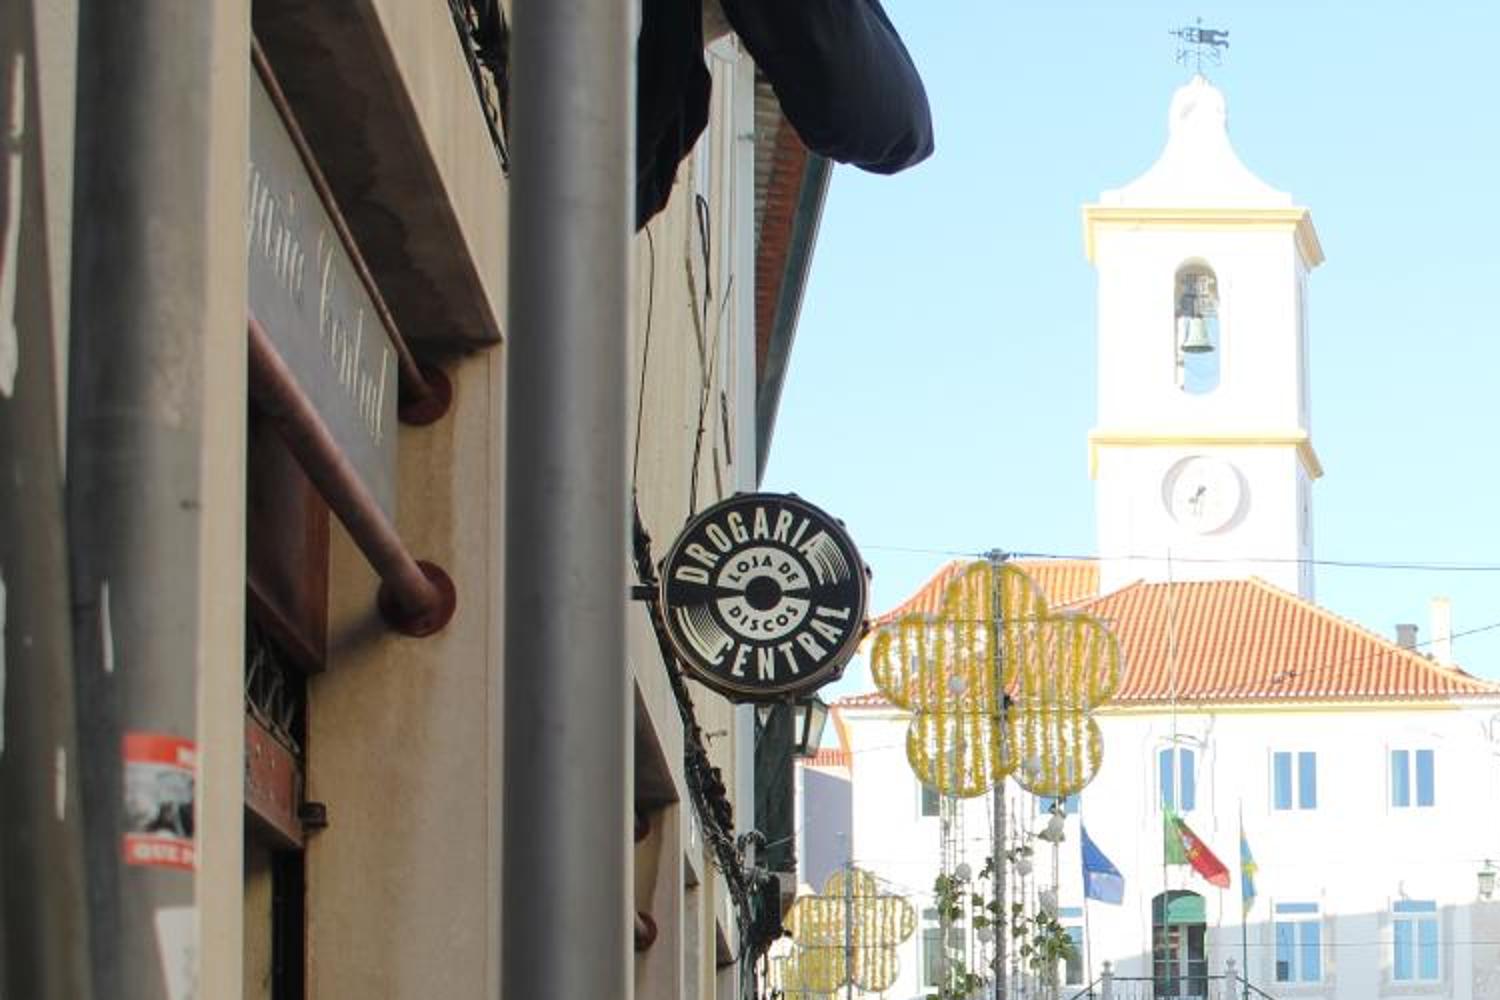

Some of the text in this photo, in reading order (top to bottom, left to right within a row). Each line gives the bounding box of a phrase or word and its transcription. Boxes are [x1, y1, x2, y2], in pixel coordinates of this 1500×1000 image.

[676, 507, 824, 585] DROGARIA
[728, 556, 800, 584] LOJA DE
[710, 605, 851, 680] CENTRAL
[728, 606, 799, 632] DISCOS
